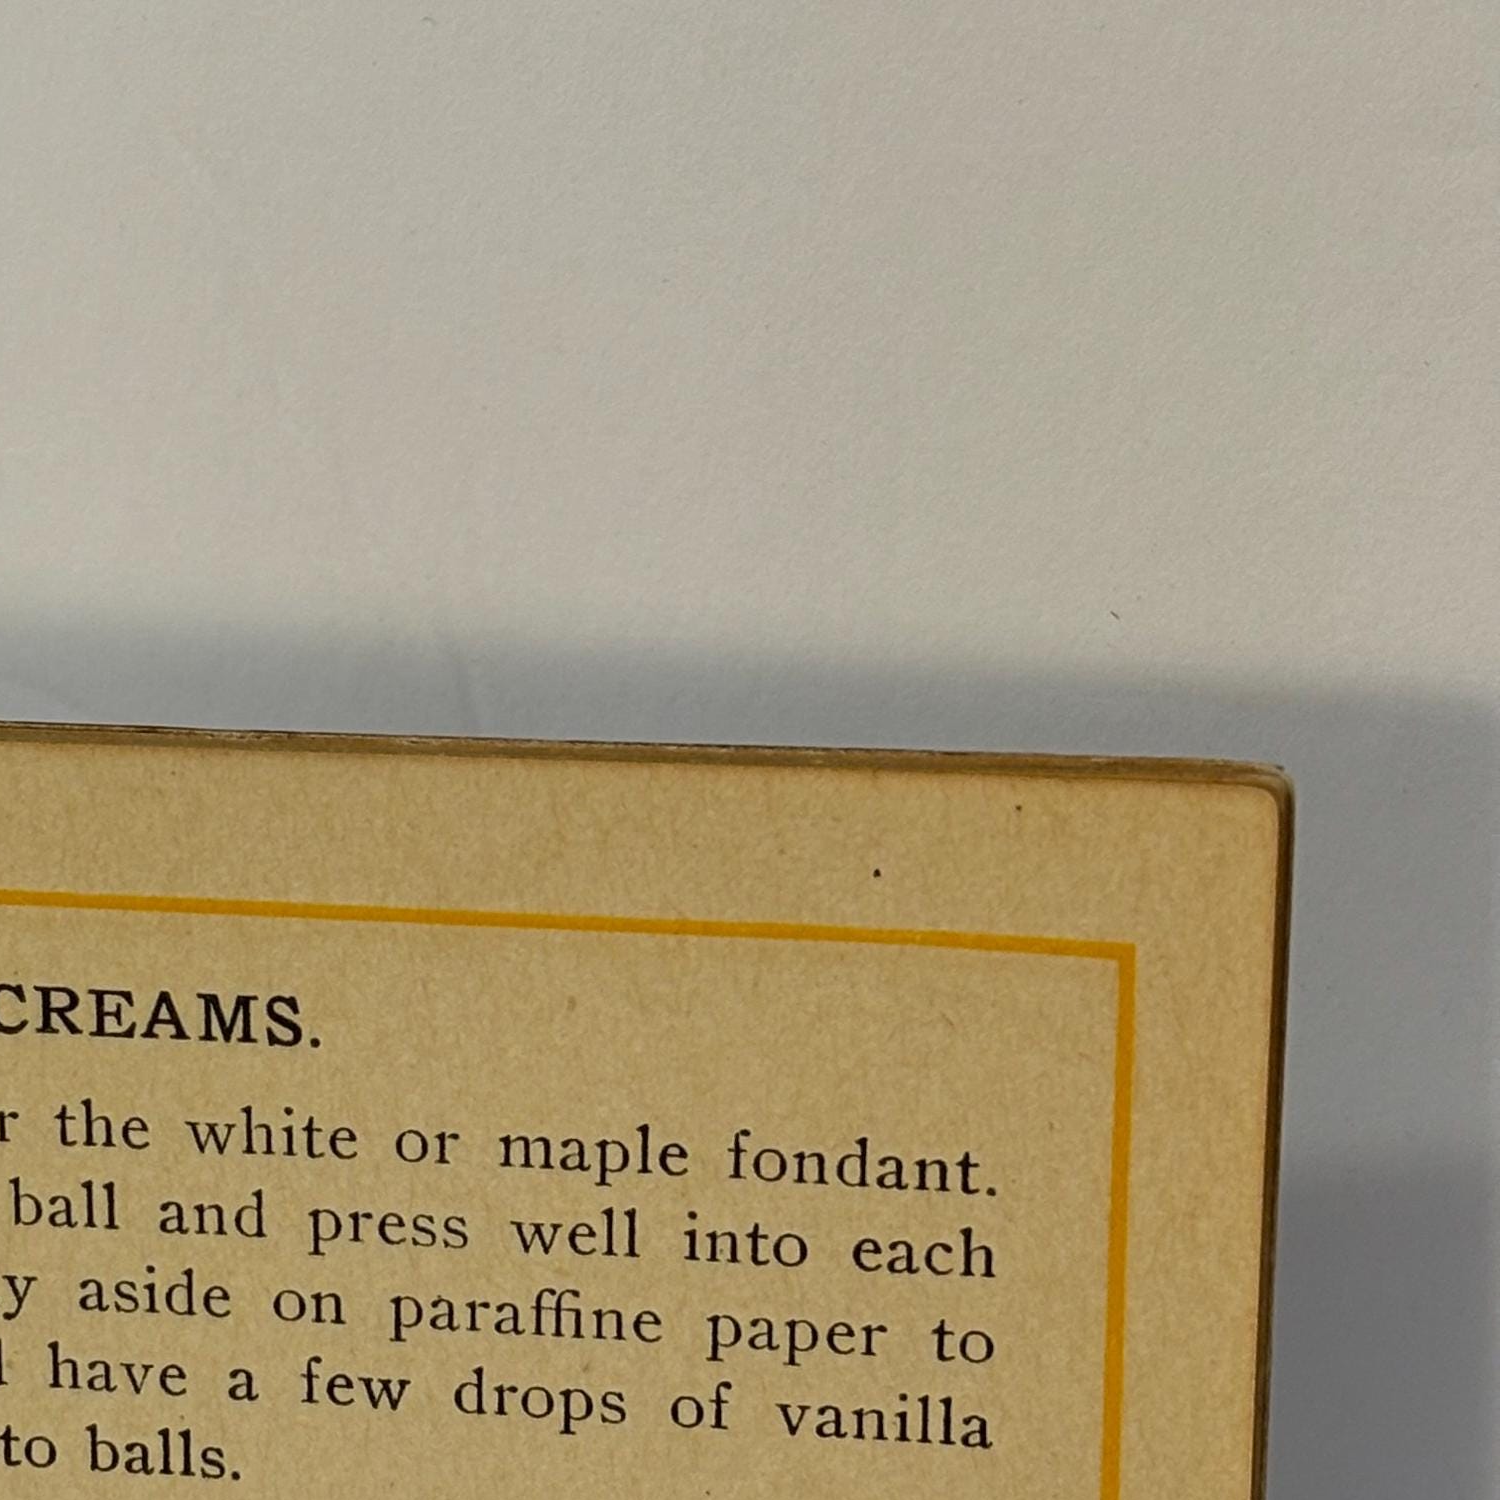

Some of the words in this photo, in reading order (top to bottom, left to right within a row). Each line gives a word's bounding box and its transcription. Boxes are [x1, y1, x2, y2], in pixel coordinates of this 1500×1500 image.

[53, 1097, 151, 1151] the
[184, 1104, 358, 1160] white
[395, 1129, 461, 1165] or
[498, 1123, 689, 1188] maple
[726, 1128, 997, 1197] fondant.
[8, 1176, 120, 1231] ball
[158, 1188, 268, 1239] and
[307, 1208, 469, 1257] press
[509, 1206, 641, 1258] well
[683, 1210, 808, 1268] into
[851, 1226, 997, 1279] each
[78, 1264, 232, 1319] aside
[272, 1289, 347, 1325] on
[388, 1287, 663, 1344] paraffine
[705, 1314, 888, 1367] paper
[931, 1318, 995, 1365] to
[47, 1340, 187, 1397] have
[227, 1368, 260, 1402] a
[300, 1355, 412, 1412] few
[453, 1365, 627, 1436] drops
[670, 1380, 733, 1431] of
[775, 1392, 994, 1450] vanilla
[85, 1423, 241, 1482] balls.
